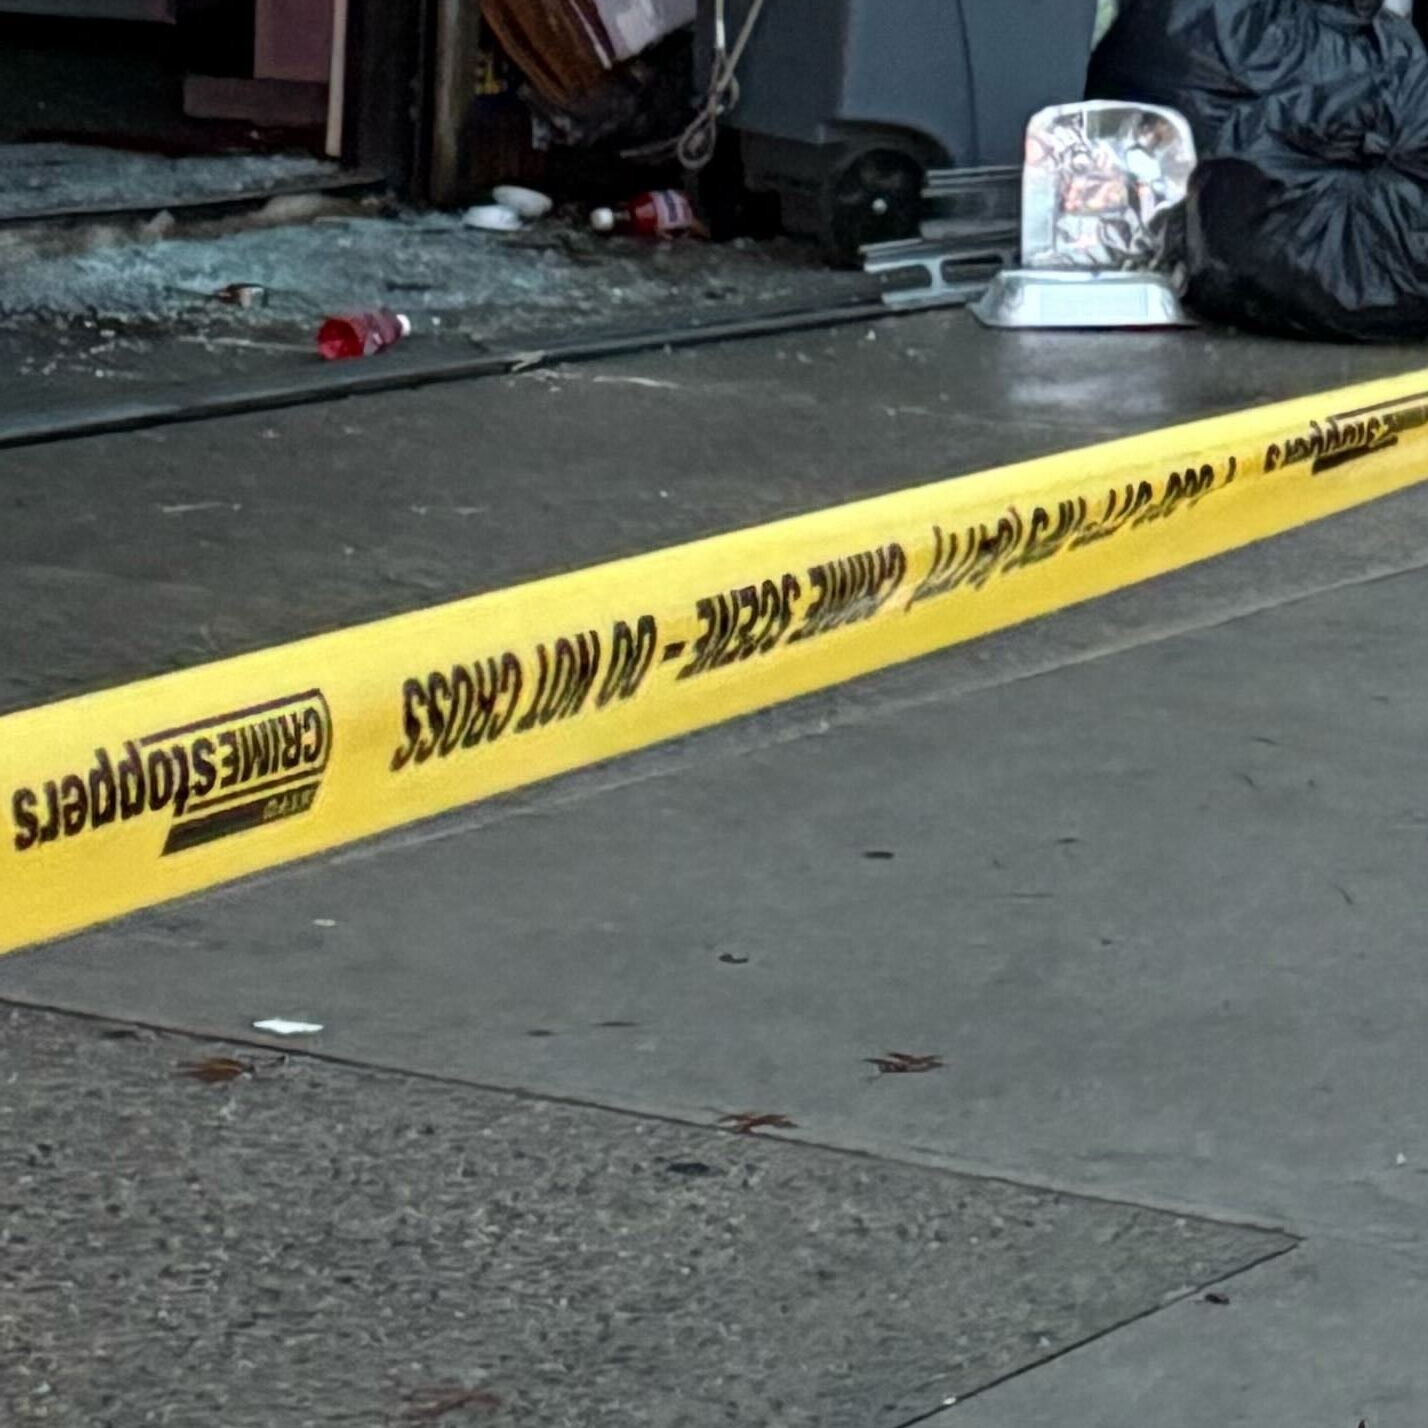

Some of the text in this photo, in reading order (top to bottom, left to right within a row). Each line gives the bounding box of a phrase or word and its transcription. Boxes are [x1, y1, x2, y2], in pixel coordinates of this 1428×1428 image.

[598, 614, 656, 706] DO
[676, 573, 802, 681] SCENE
[389, 656, 525, 772] CROSS
[515, 629, 600, 730] NOT
